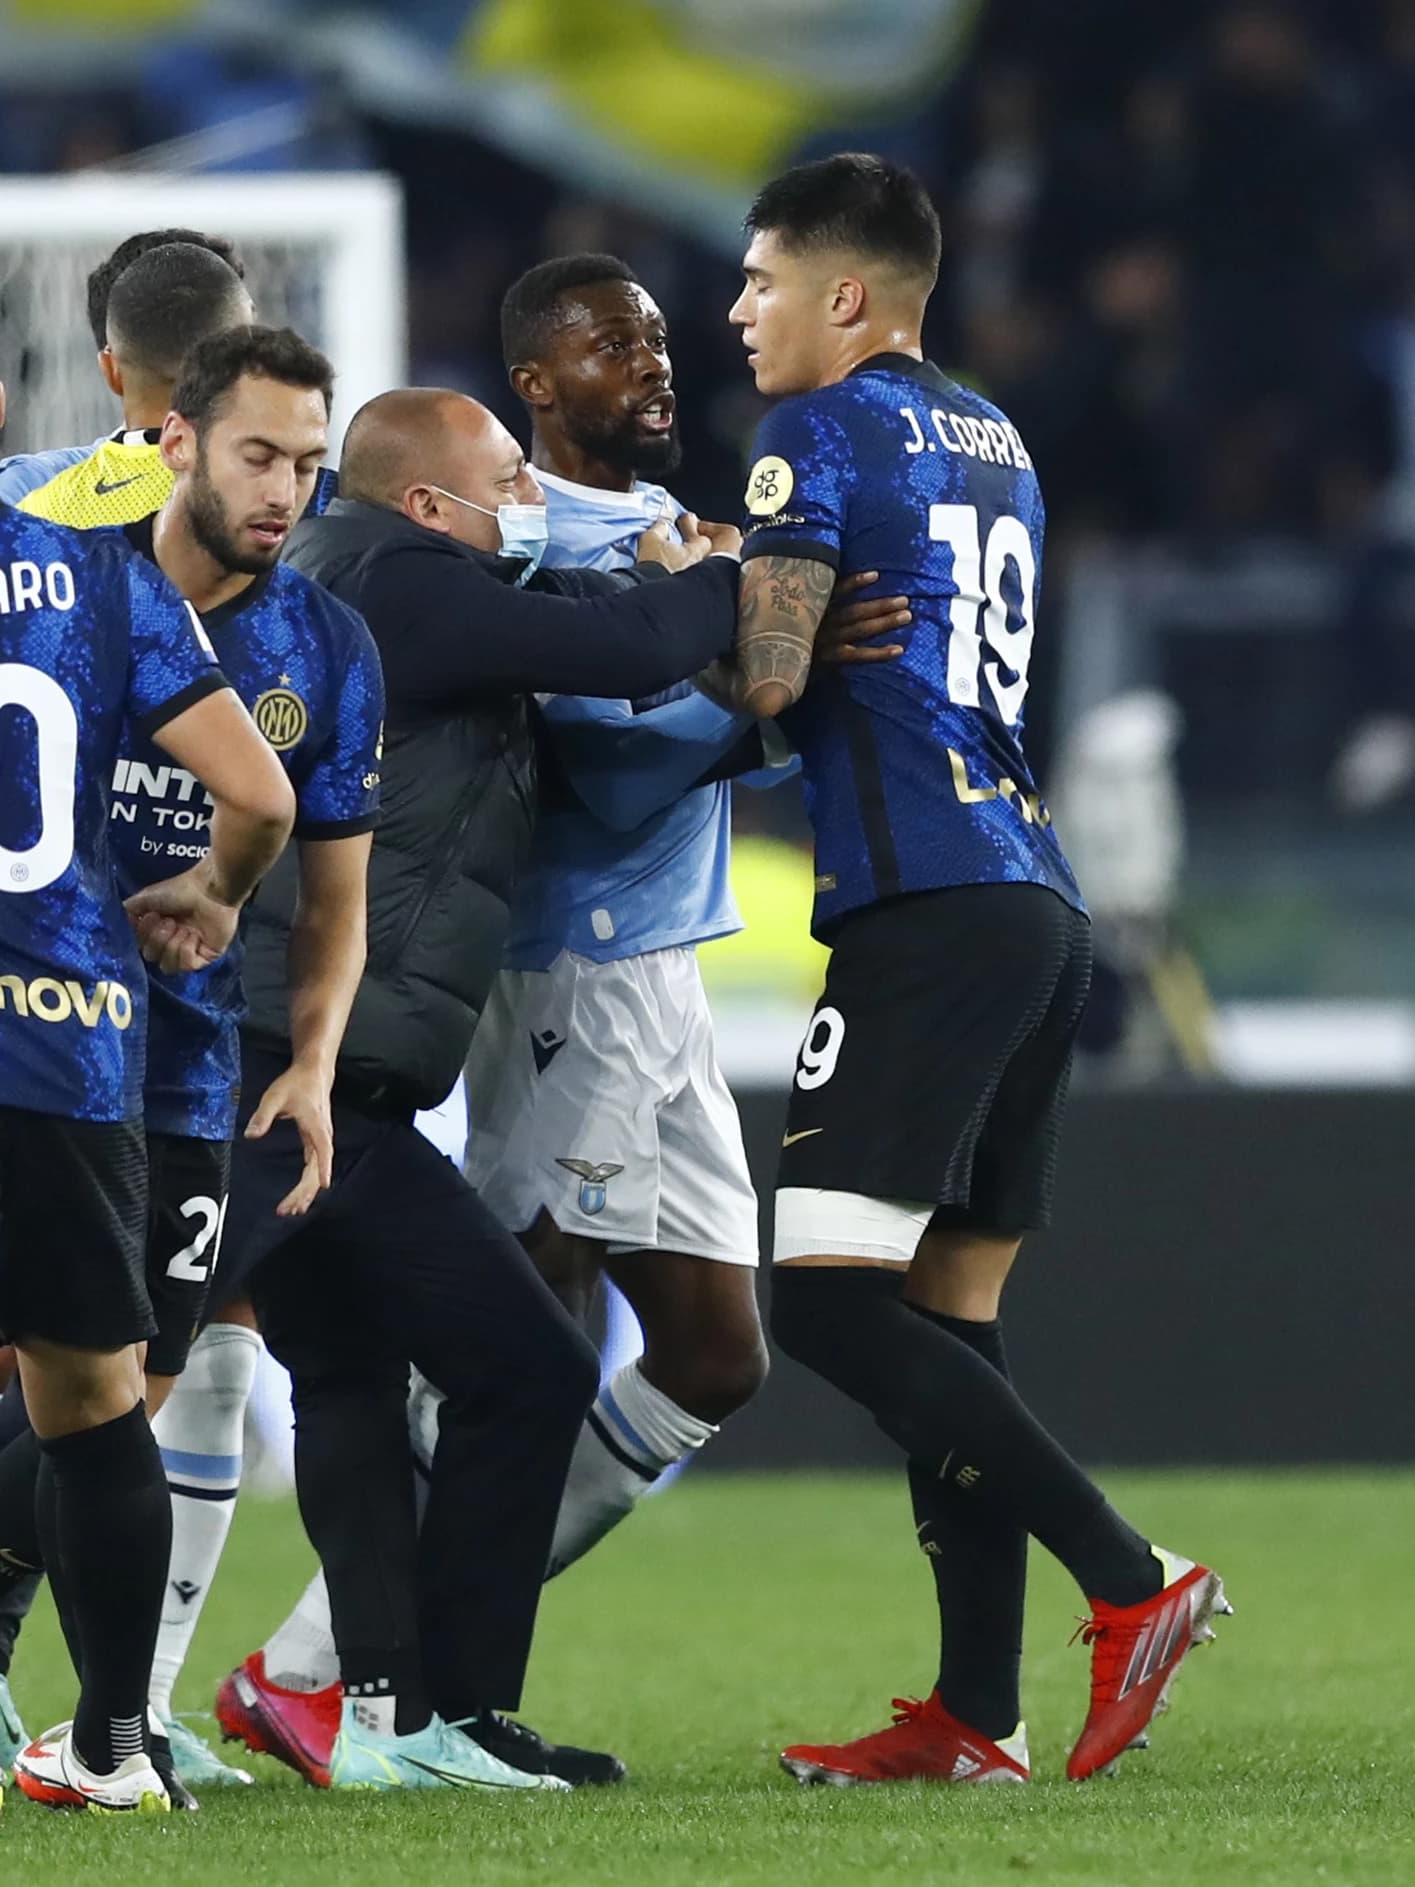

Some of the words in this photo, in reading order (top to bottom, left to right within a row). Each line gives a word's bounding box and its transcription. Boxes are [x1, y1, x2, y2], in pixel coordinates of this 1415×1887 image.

[930, 408, 1034, 471] CORRE
[928, 503, 1035, 726] 19
[140, 835, 164, 856] by
[166, 1192, 230, 1283] 2
